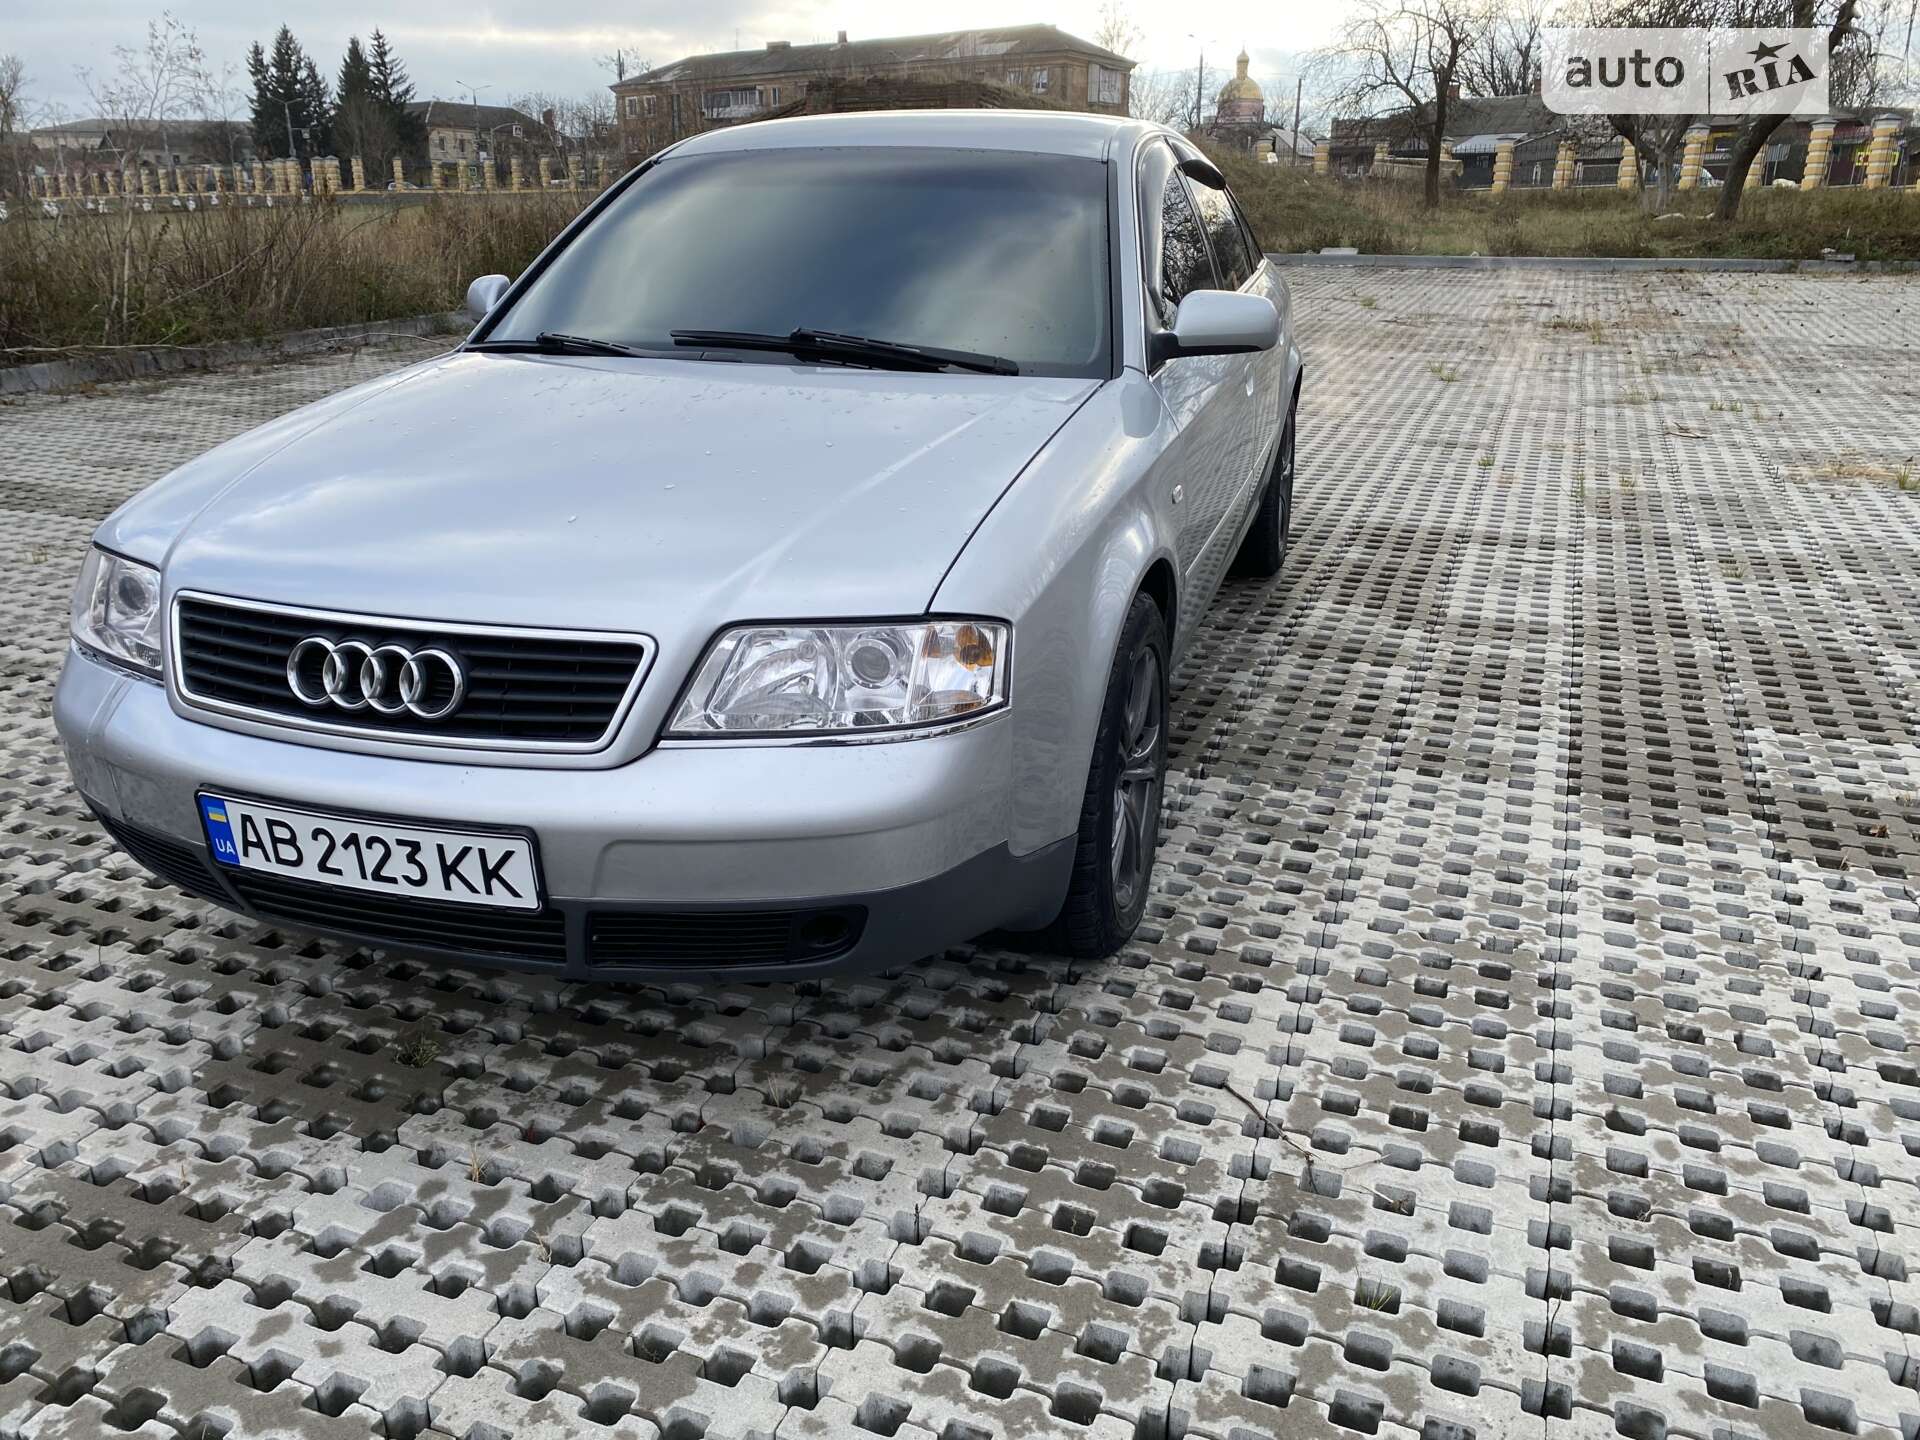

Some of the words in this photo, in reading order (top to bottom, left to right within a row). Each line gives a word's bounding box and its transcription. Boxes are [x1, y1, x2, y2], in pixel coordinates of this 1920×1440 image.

[215, 838, 236, 855] UA
[240, 813, 304, 868] AB
[311, 827, 428, 888] 2123
[436, 843, 523, 898] KK
